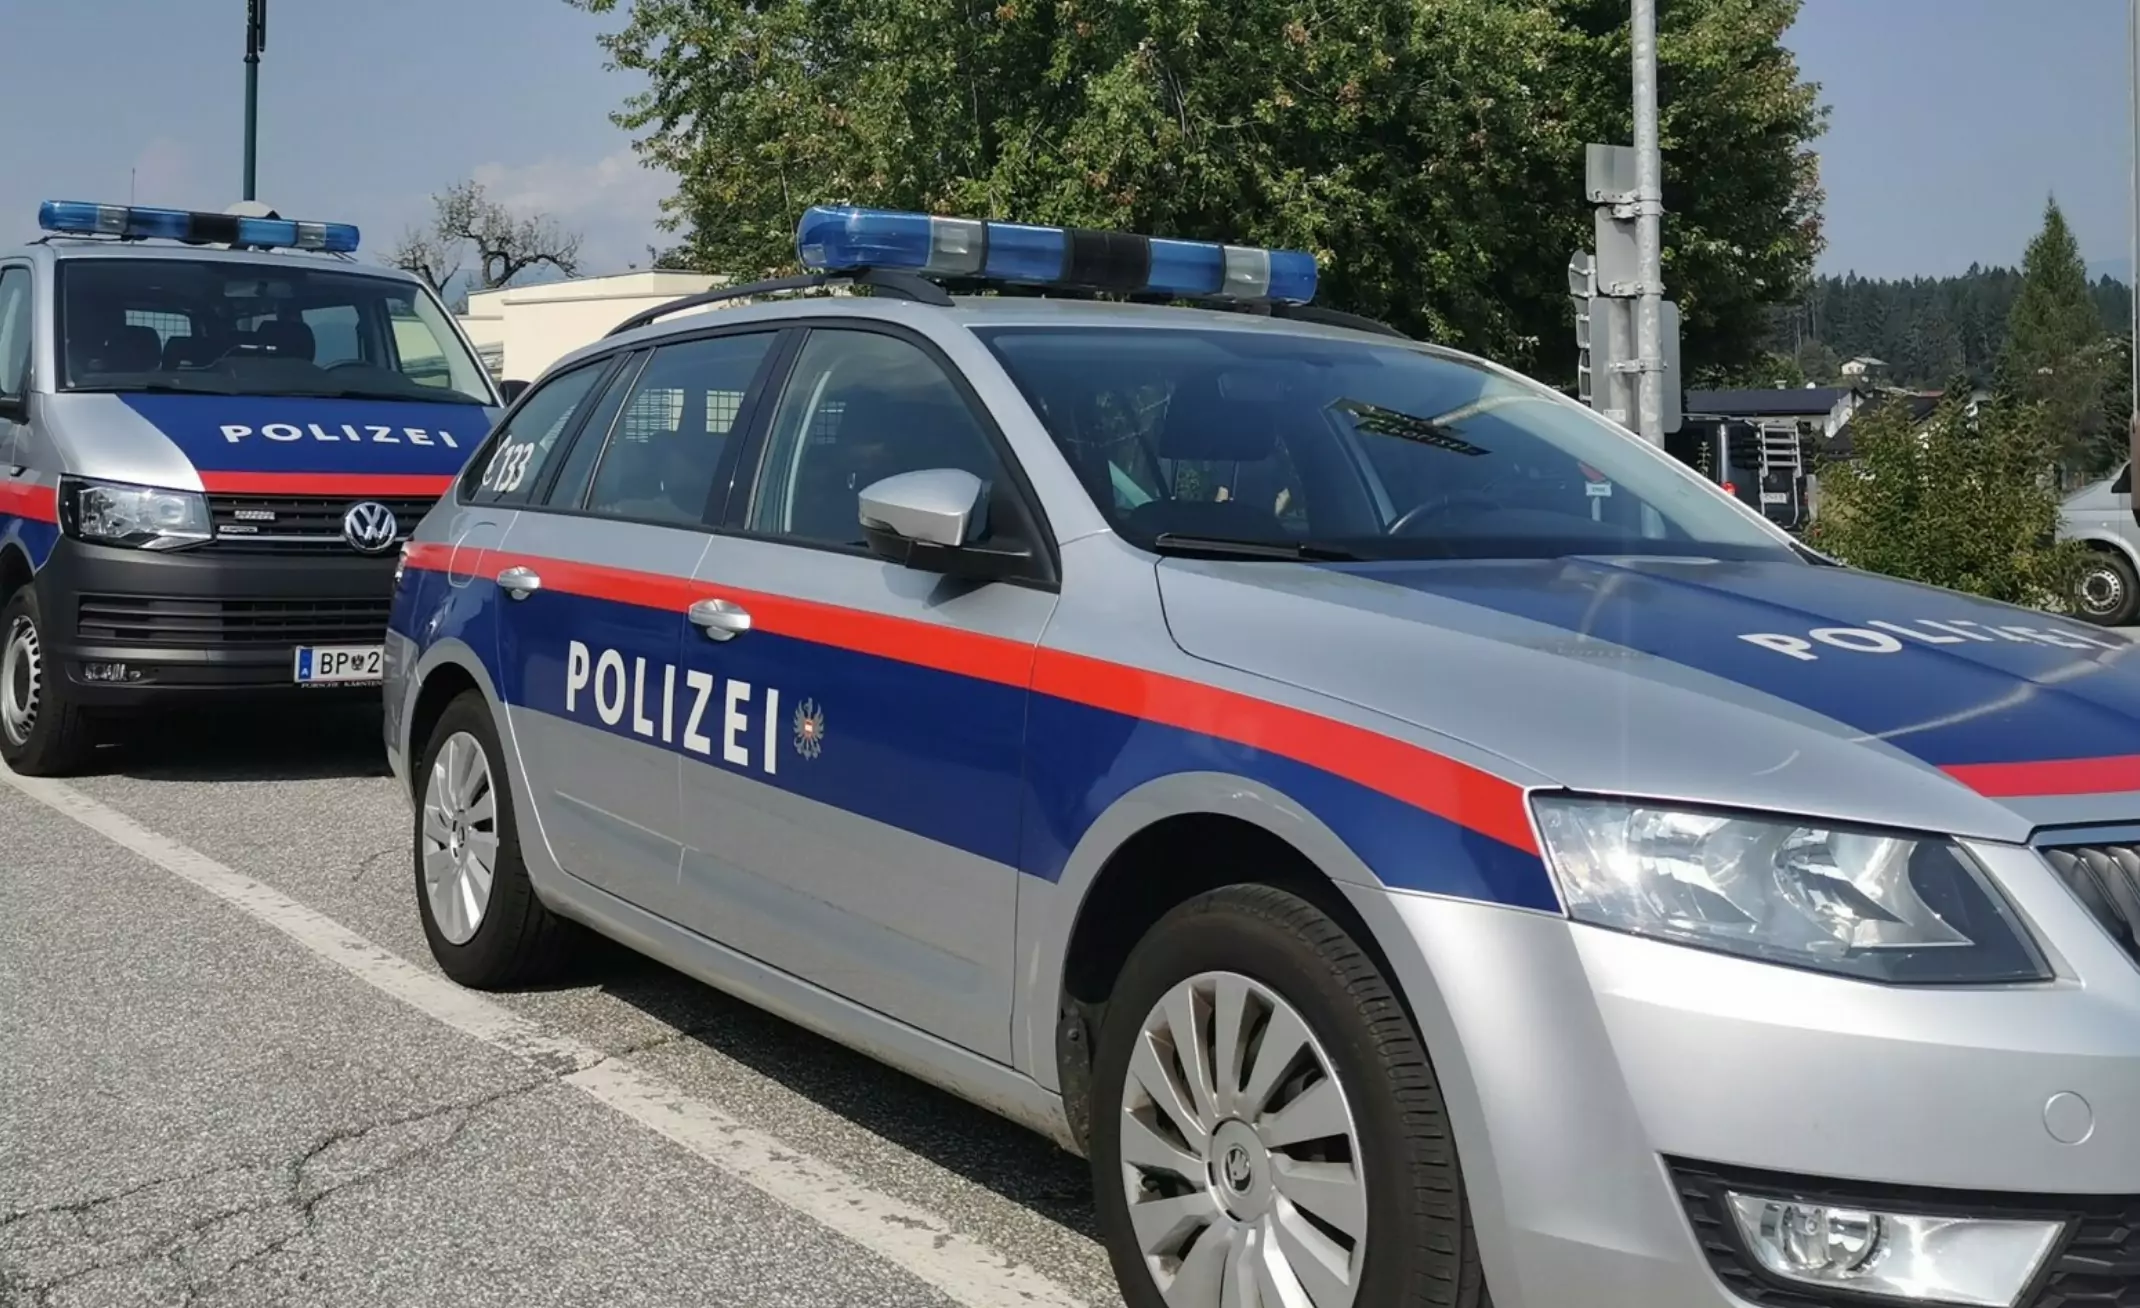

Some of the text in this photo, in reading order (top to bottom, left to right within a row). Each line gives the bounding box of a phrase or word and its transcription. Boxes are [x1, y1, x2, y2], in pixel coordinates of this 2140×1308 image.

[219, 423, 459, 448] POLIZEI
[493, 442, 535, 492] 133
[320, 651, 380, 675] BP 2
[566, 640, 779, 774] POLIZEI
